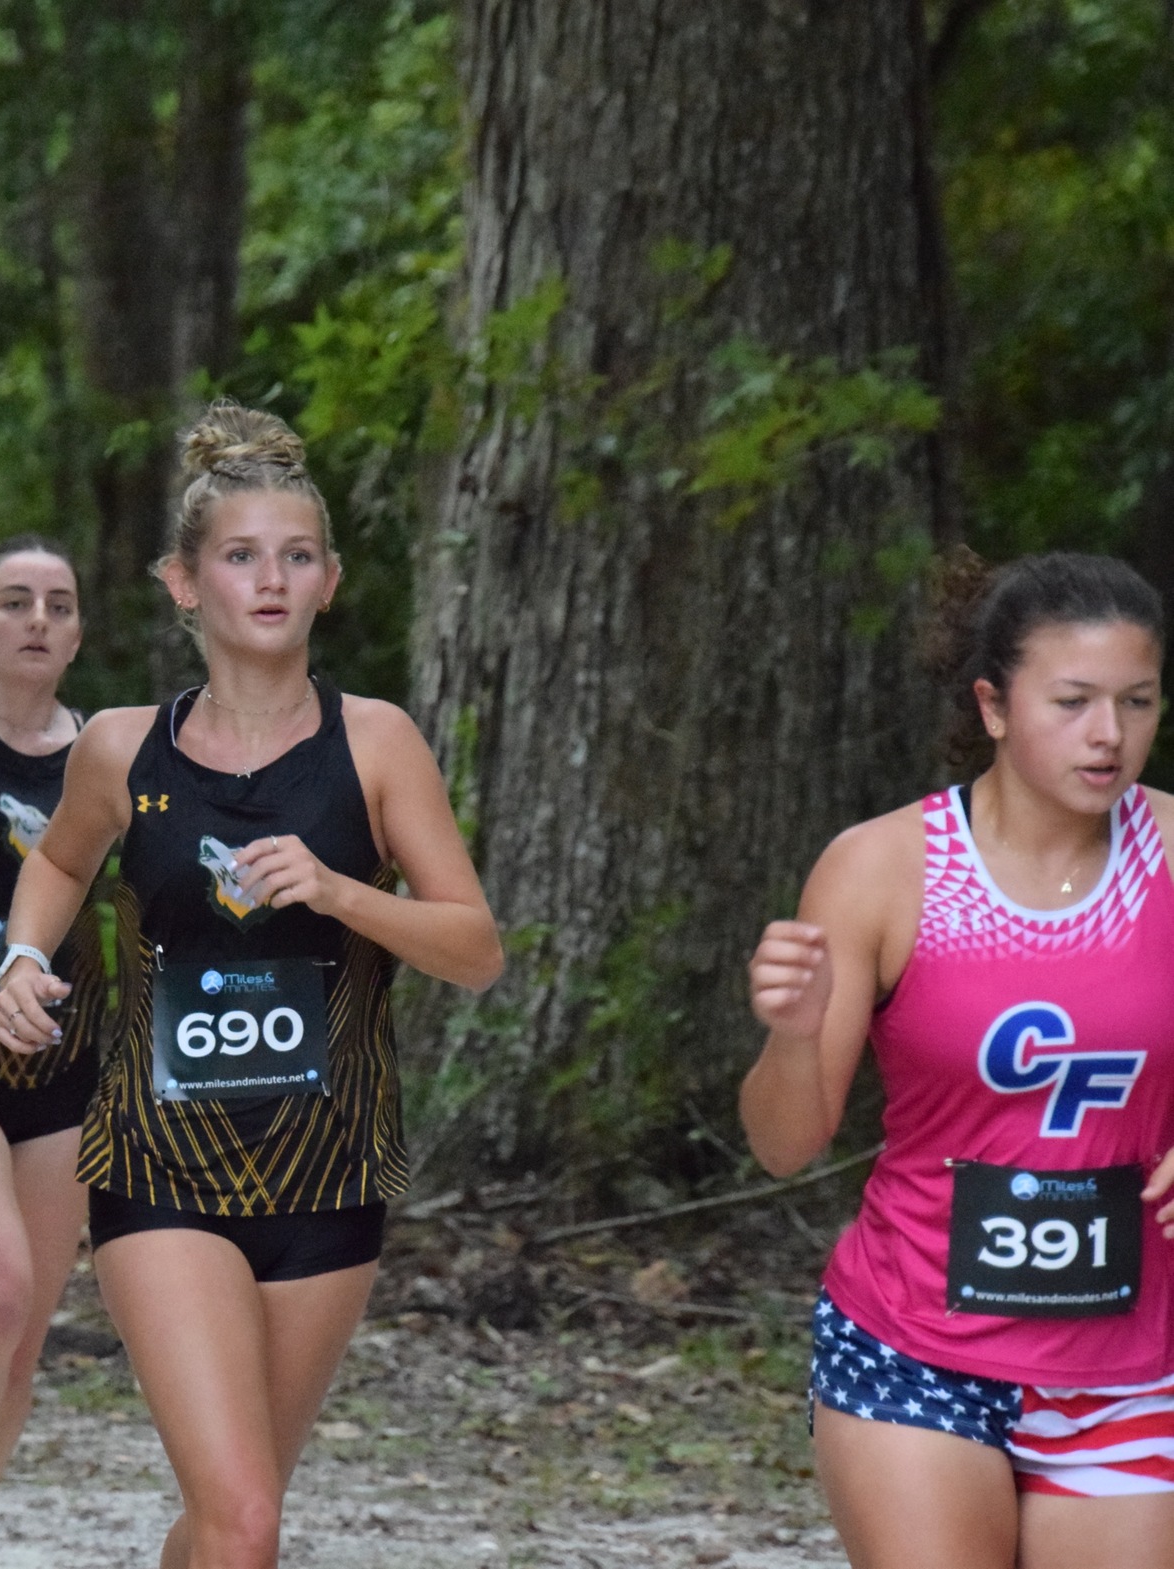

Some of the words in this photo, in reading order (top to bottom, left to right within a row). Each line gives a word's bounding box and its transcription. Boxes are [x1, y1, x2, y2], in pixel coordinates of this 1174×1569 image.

[177, 1007, 304, 1058] 690
[179, 1073, 306, 1090] www.milesandminutes.net
[977, 1000, 1148, 1138] CF
[978, 1216, 1109, 1271] 391
[975, 1289, 1119, 1304] www.milesandminutes.net
